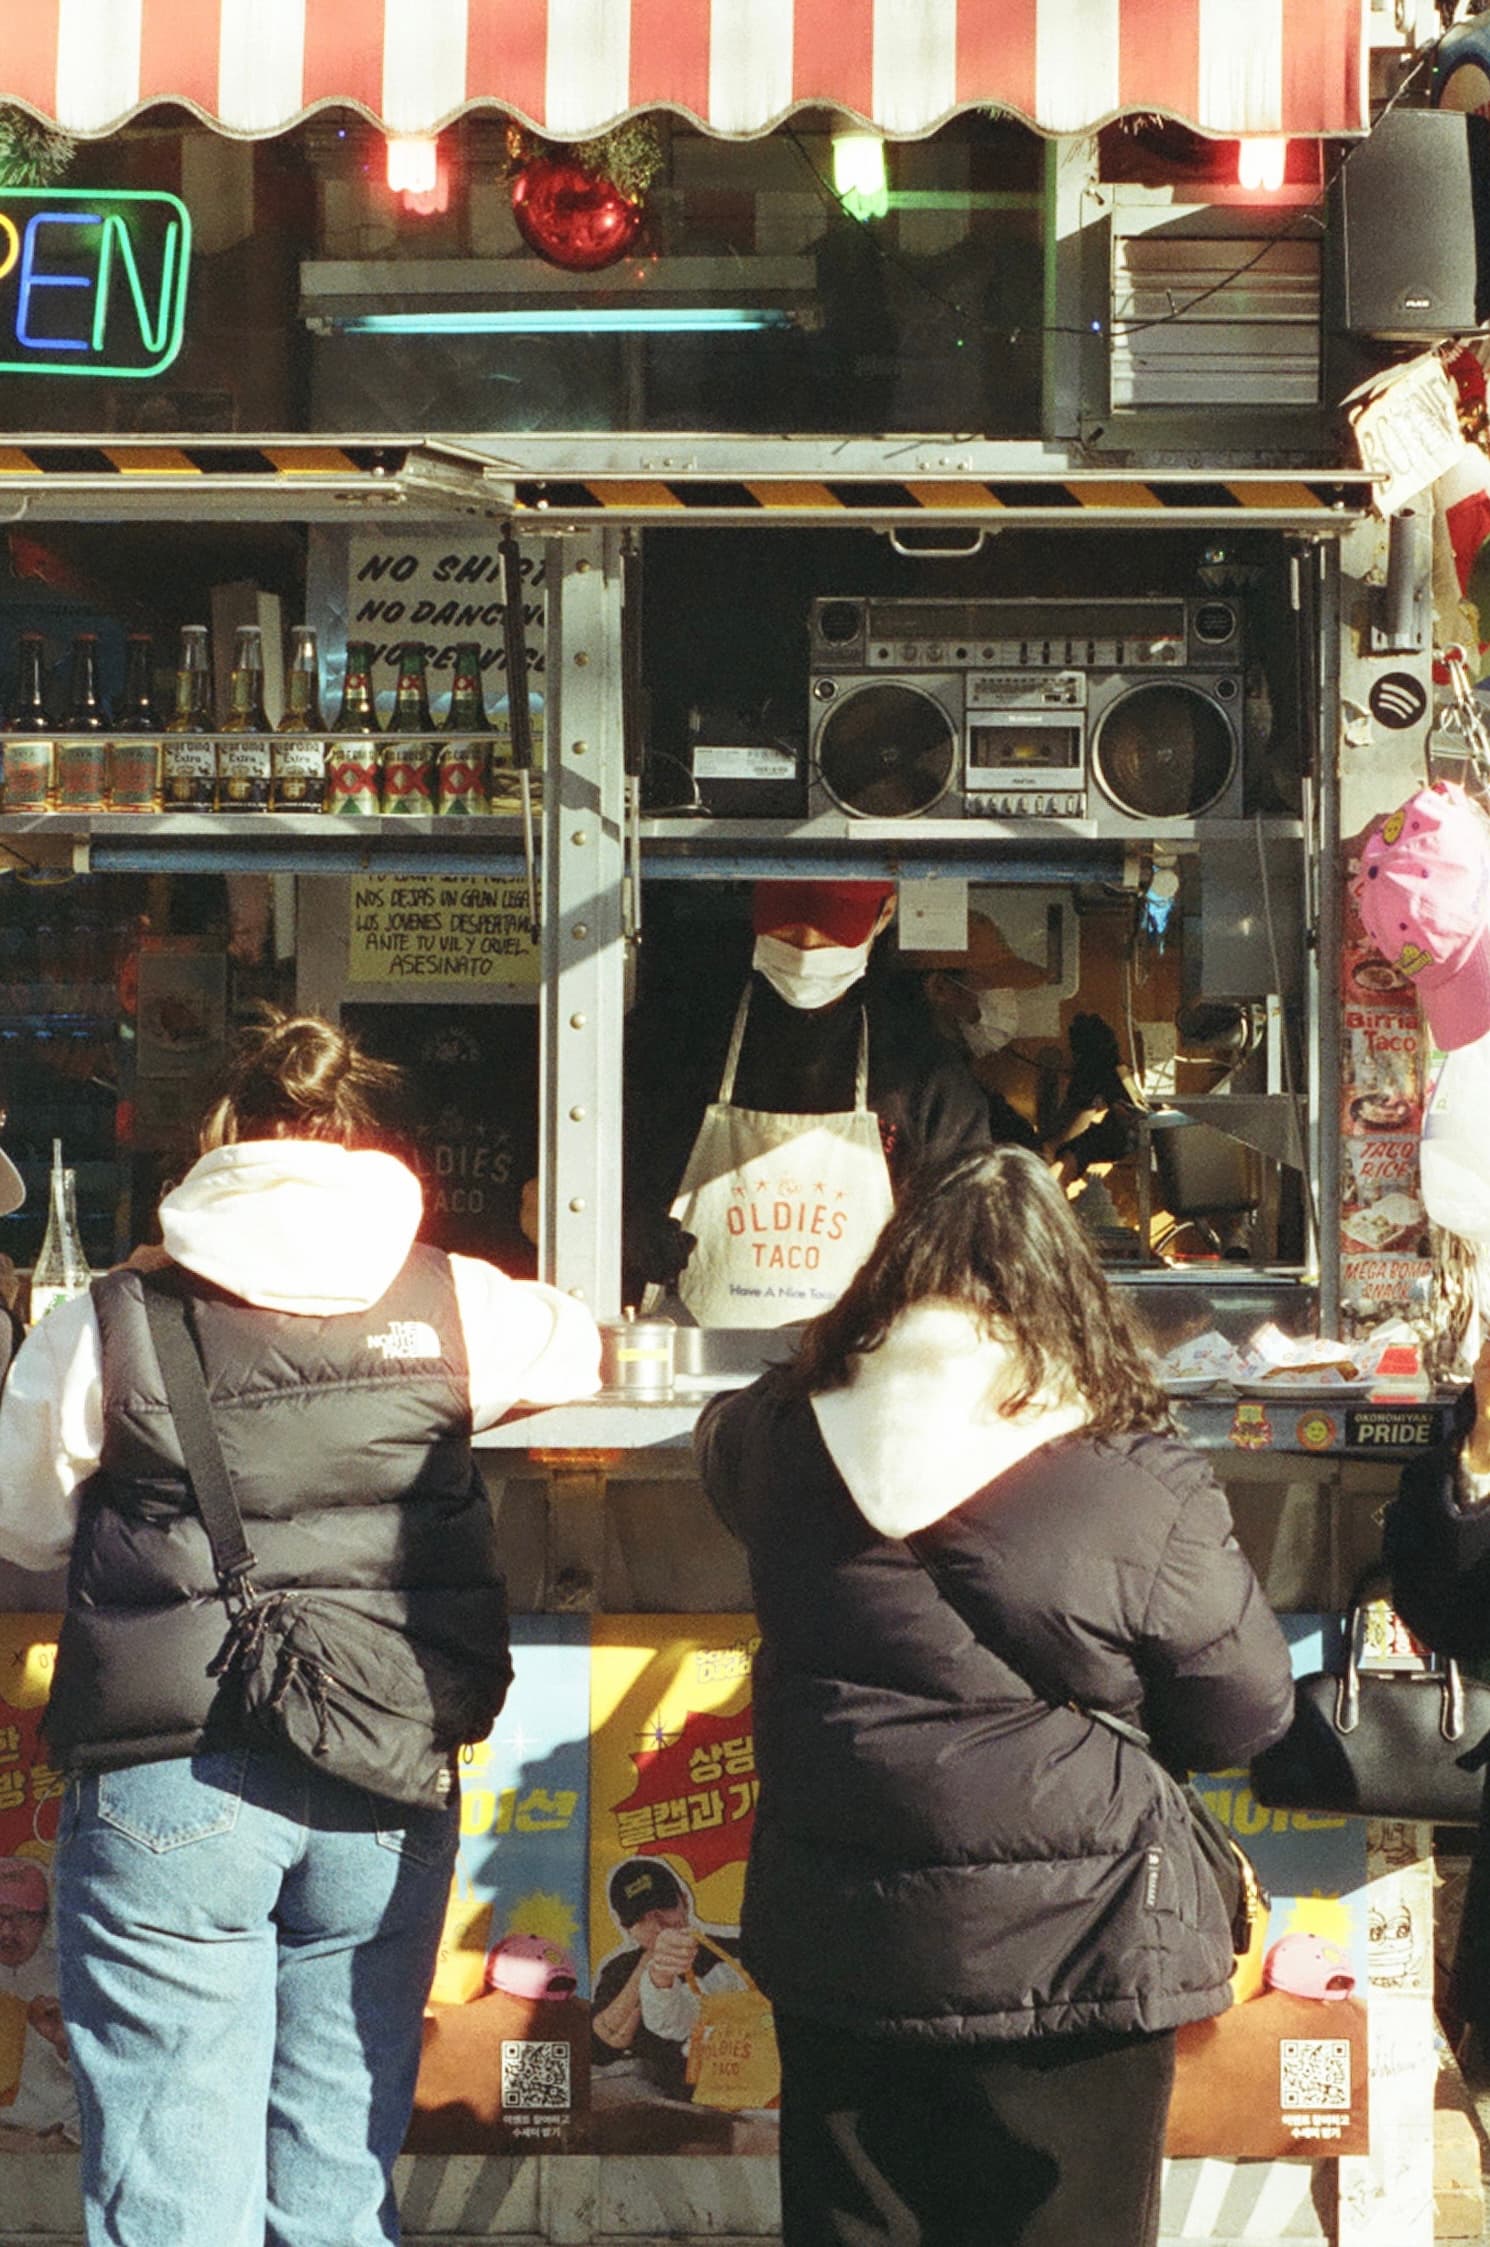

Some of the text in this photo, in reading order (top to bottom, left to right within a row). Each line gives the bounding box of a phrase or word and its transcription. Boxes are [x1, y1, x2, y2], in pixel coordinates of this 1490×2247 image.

[357, 554, 419, 582] NO
[356, 599, 406, 624] NO
[355, 888, 384, 909] NOS
[355, 913, 379, 932] LOS
[365, 932, 409, 951] ANTE
[416, 934, 436, 950] TU
[464, 936, 476, 954] Y
[480, 936, 529, 956] CRUEL
[389, 953, 493, 977] ASESINATO
[1344, 1011, 1419, 1029] Birria
[1364, 1031, 1416, 1055] Taco
[1360, 1142, 1414, 1160] TACO
[727, 1201, 848, 1240] OLDIES
[751, 1243, 820, 1270] TACO
[1344, 1260, 1387, 1280] MEGA
[729, 1283, 762, 1298] Have
[765, 1287, 776, 1298] A
[1357, 1424, 1431, 1444] PRIDE
